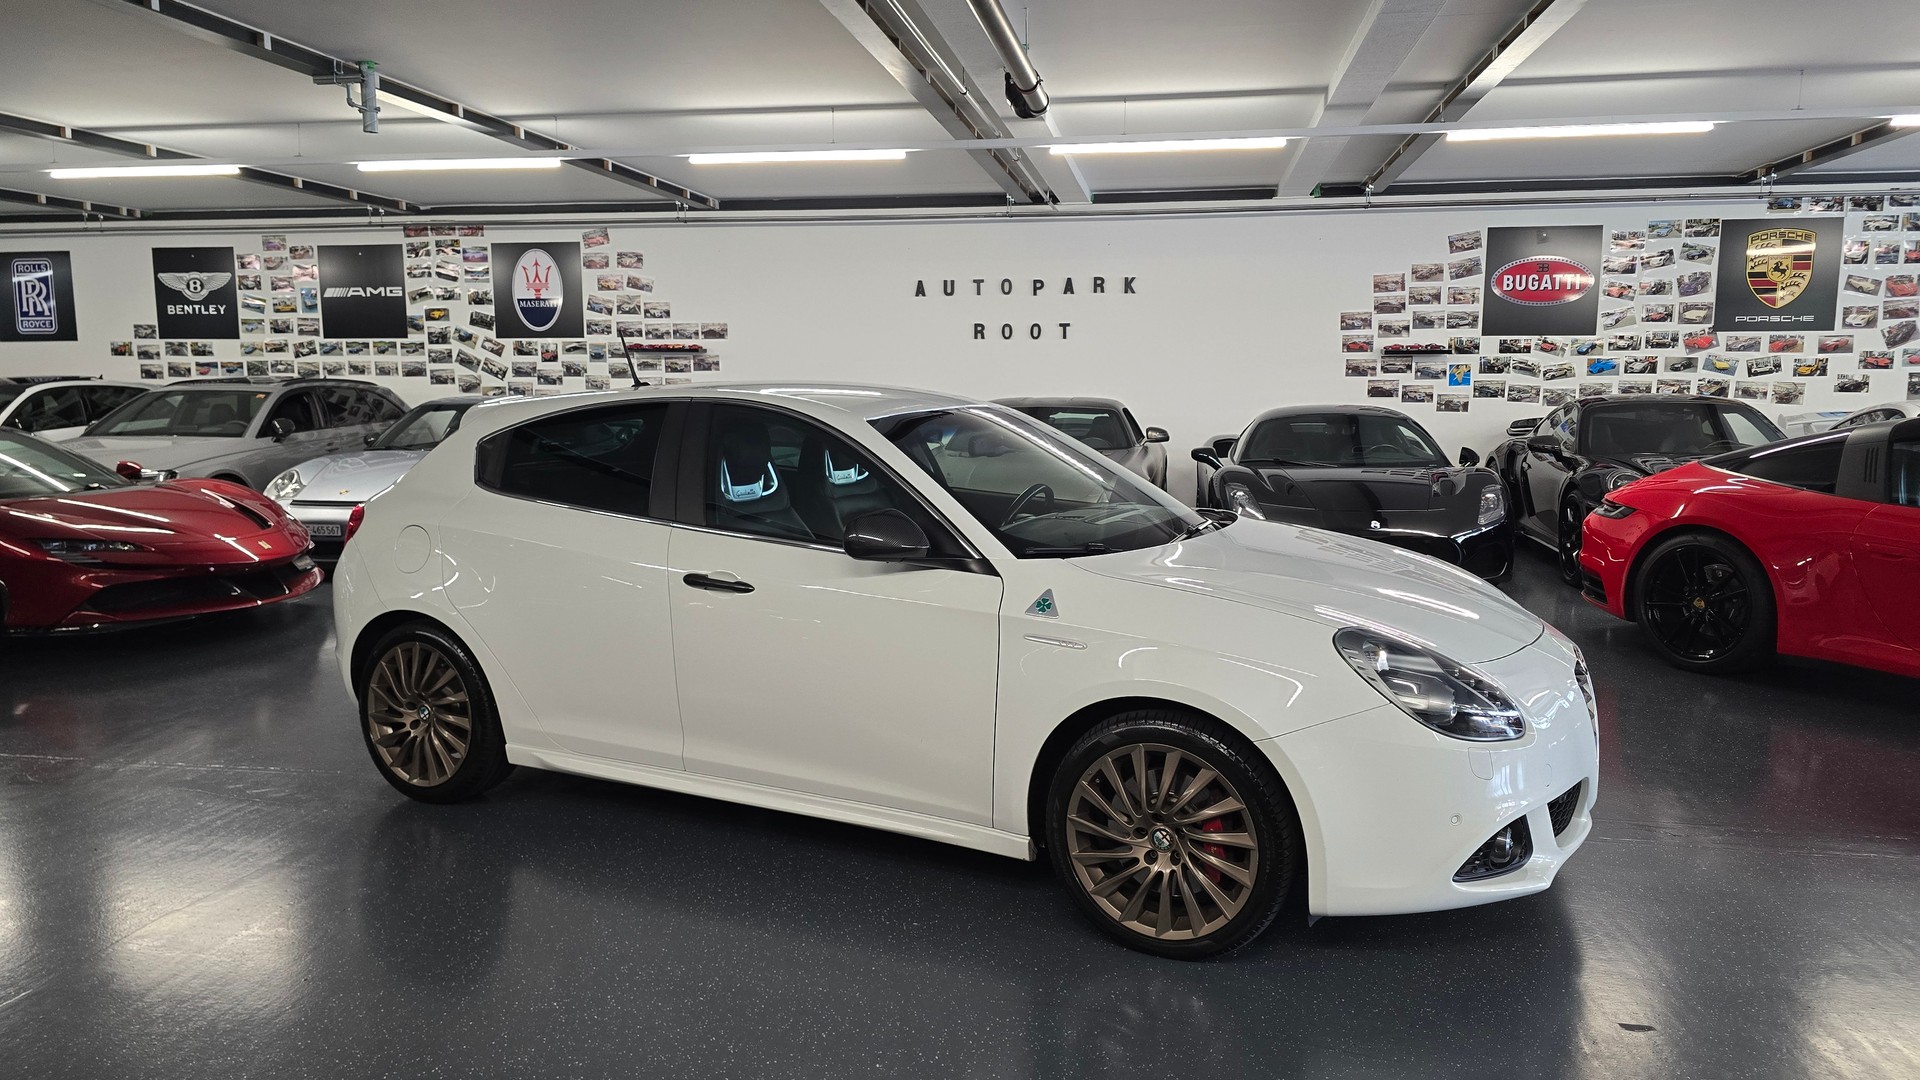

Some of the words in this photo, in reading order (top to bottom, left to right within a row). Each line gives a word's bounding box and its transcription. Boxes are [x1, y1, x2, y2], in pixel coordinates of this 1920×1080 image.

[1750, 231, 1813, 244] PORSCHE
[17, 264, 46, 273] ROLLS
[914, 276, 1136, 297] AUTOPARK
[1502, 273, 1582, 291] BUGATTI
[346, 286, 403, 298] AMG
[167, 304, 226, 315] BENTLEY
[22, 320, 52, 328] ROYCE
[1735, 315, 1815, 323] PORSCHE
[972, 322, 1071, 340] ROOT
